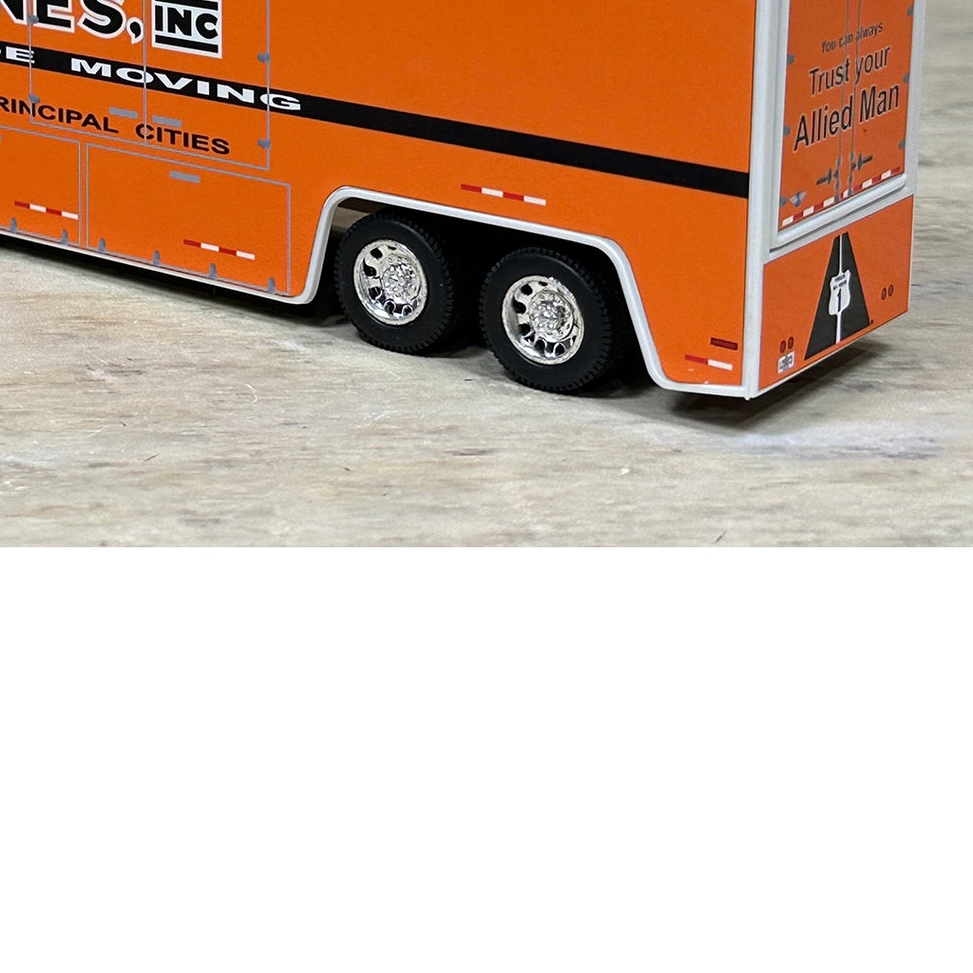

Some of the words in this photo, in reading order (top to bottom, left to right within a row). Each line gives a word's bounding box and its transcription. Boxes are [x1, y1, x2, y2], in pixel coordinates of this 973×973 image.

[153, 0, 221, 43] INC
[821, 38, 836, 53] You
[839, 34, 854, 47] can
[856, 22, 883, 42] always
[71, 58, 301, 110] MOVING
[809, 55, 850, 96] Trust
[854, 46, 890, 84] your
[135, 123, 230, 155] CITIES
[793, 95, 853, 152] Allied
[859, 83, 900, 124] Man
[836, 288, 842, 312] 1
